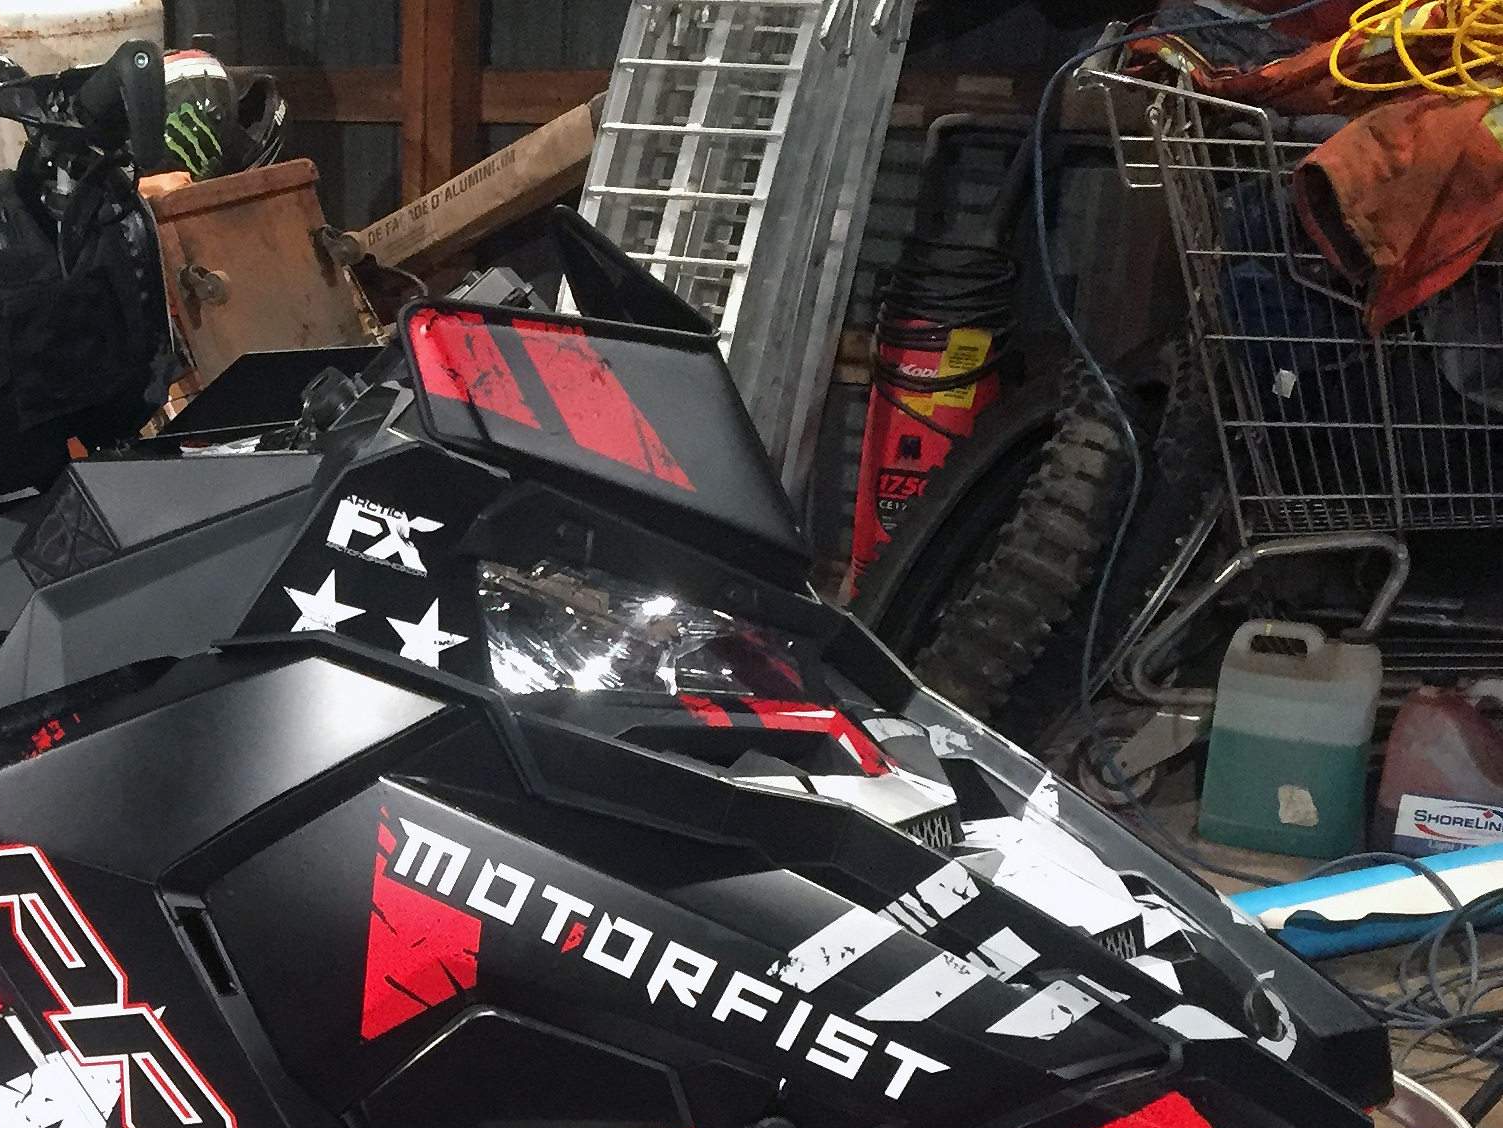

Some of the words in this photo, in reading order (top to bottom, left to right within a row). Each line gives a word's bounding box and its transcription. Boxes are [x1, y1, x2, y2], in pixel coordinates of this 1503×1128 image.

[345, 495, 406, 521] ARCTIC
[327, 499, 445, 574] FX
[1413, 809, 1503, 833] SHORELIN
[393, 817, 952, 1101] MOTORFIST
